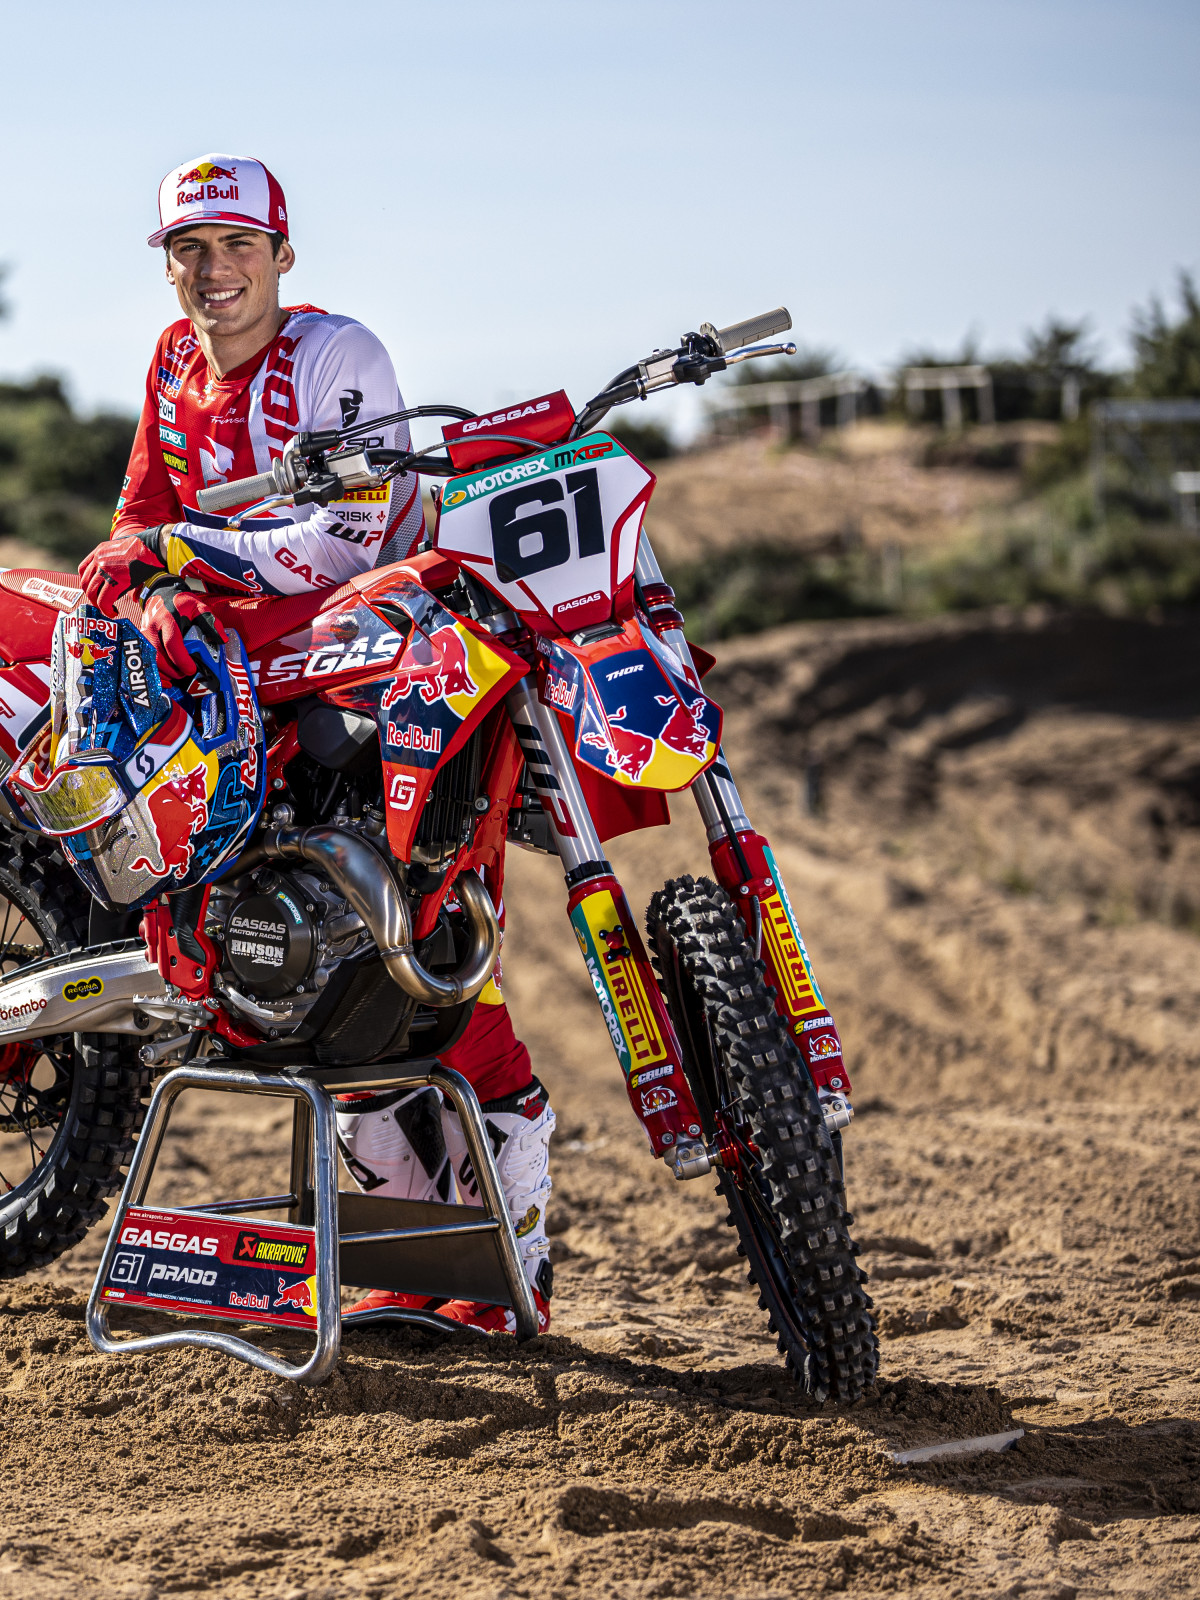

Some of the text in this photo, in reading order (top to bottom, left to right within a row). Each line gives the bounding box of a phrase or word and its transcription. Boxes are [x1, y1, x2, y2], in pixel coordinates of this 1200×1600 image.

[176, 184, 240, 206] Red Bull
[462, 400, 551, 433] GASGAS
[466, 441, 614, 499] MOTOREX MXGP
[343, 491, 387, 501] RELLI
[488, 467, 606, 584] 61
[557, 592, 602, 613] GASGAS
[64, 616, 118, 641] Red Bull
[249, 631, 404, 687] SGAS
[123, 639, 152, 709] AIROH
[605, 664, 645, 682] THOR
[544, 673, 579, 710] Red Bull
[386, 721, 442, 754] Red Bull
[229, 927, 284, 941] FACTORY RACING
[231, 916, 287, 934] GASGAS
[231, 939, 285, 959] HINSON
[760, 900, 817, 1013] PIRELLI
[67, 983, 98, 994] REGINA
[0, 998, 48, 1021] brembo
[586, 956, 628, 1059] MOTOREX
[602, 951, 662, 1061] PIRELLI
[794, 1016, 834, 1036] SCRUB
[631, 1064, 675, 1089] SCRUB
[120, 1226, 219, 1256] GASGAS
[256, 1241, 307, 1264] AKRAPOVIČ
[110, 1252, 218, 1287] 61 PRADO
[228, 1291, 250, 1307] Red
[249, 1292, 270, 1309] Bull
